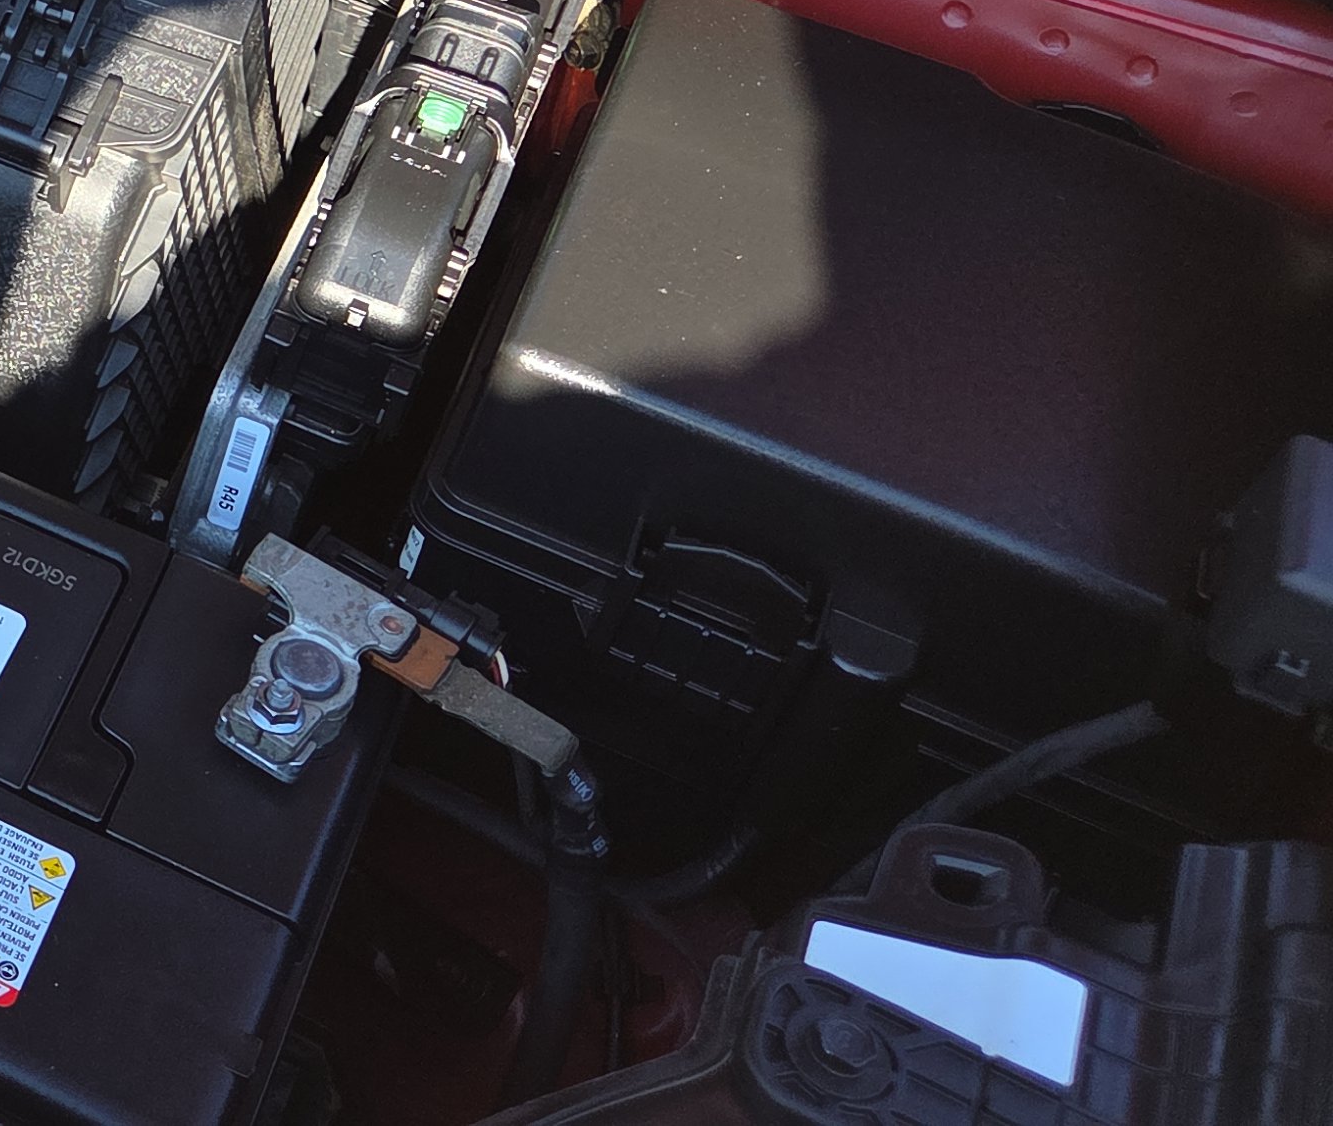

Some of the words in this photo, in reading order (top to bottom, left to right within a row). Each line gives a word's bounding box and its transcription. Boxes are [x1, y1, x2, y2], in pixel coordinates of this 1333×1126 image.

[218, 485, 239, 512] R45
[2, 547, 77, 591] 5GKD12
[567, 769, 594, 802] HS(K)
[7, 851, 36, 870] FLUSH
[27, 850, 40, 861] SE
[8, 909, 41, 930] PUEDEN
[13, 950, 26, 962] SE
